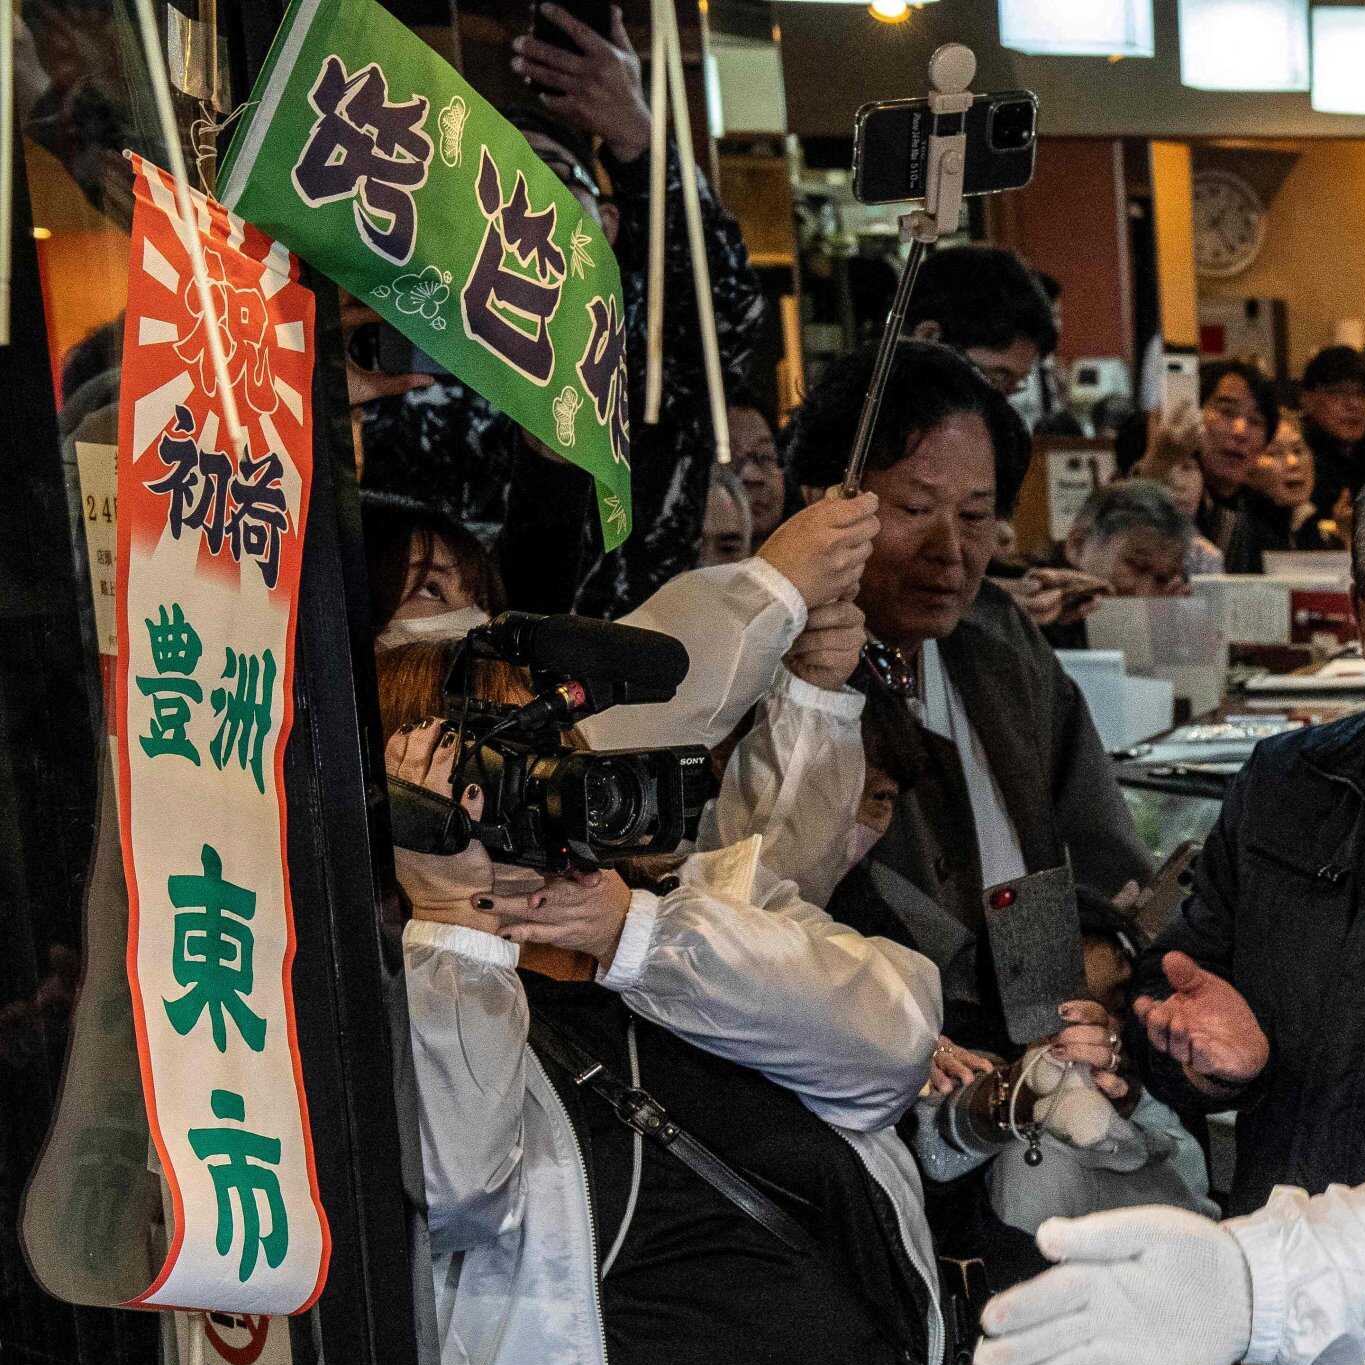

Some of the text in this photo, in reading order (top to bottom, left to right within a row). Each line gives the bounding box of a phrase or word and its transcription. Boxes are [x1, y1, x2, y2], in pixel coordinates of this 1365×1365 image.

[173, 247, 279, 415] 祝
[144, 403, 289, 590] 初荷
[136, 602, 277, 794] 豊洲
[680, 757, 705, 766] SONY
[160, 844, 290, 1282] 東市
